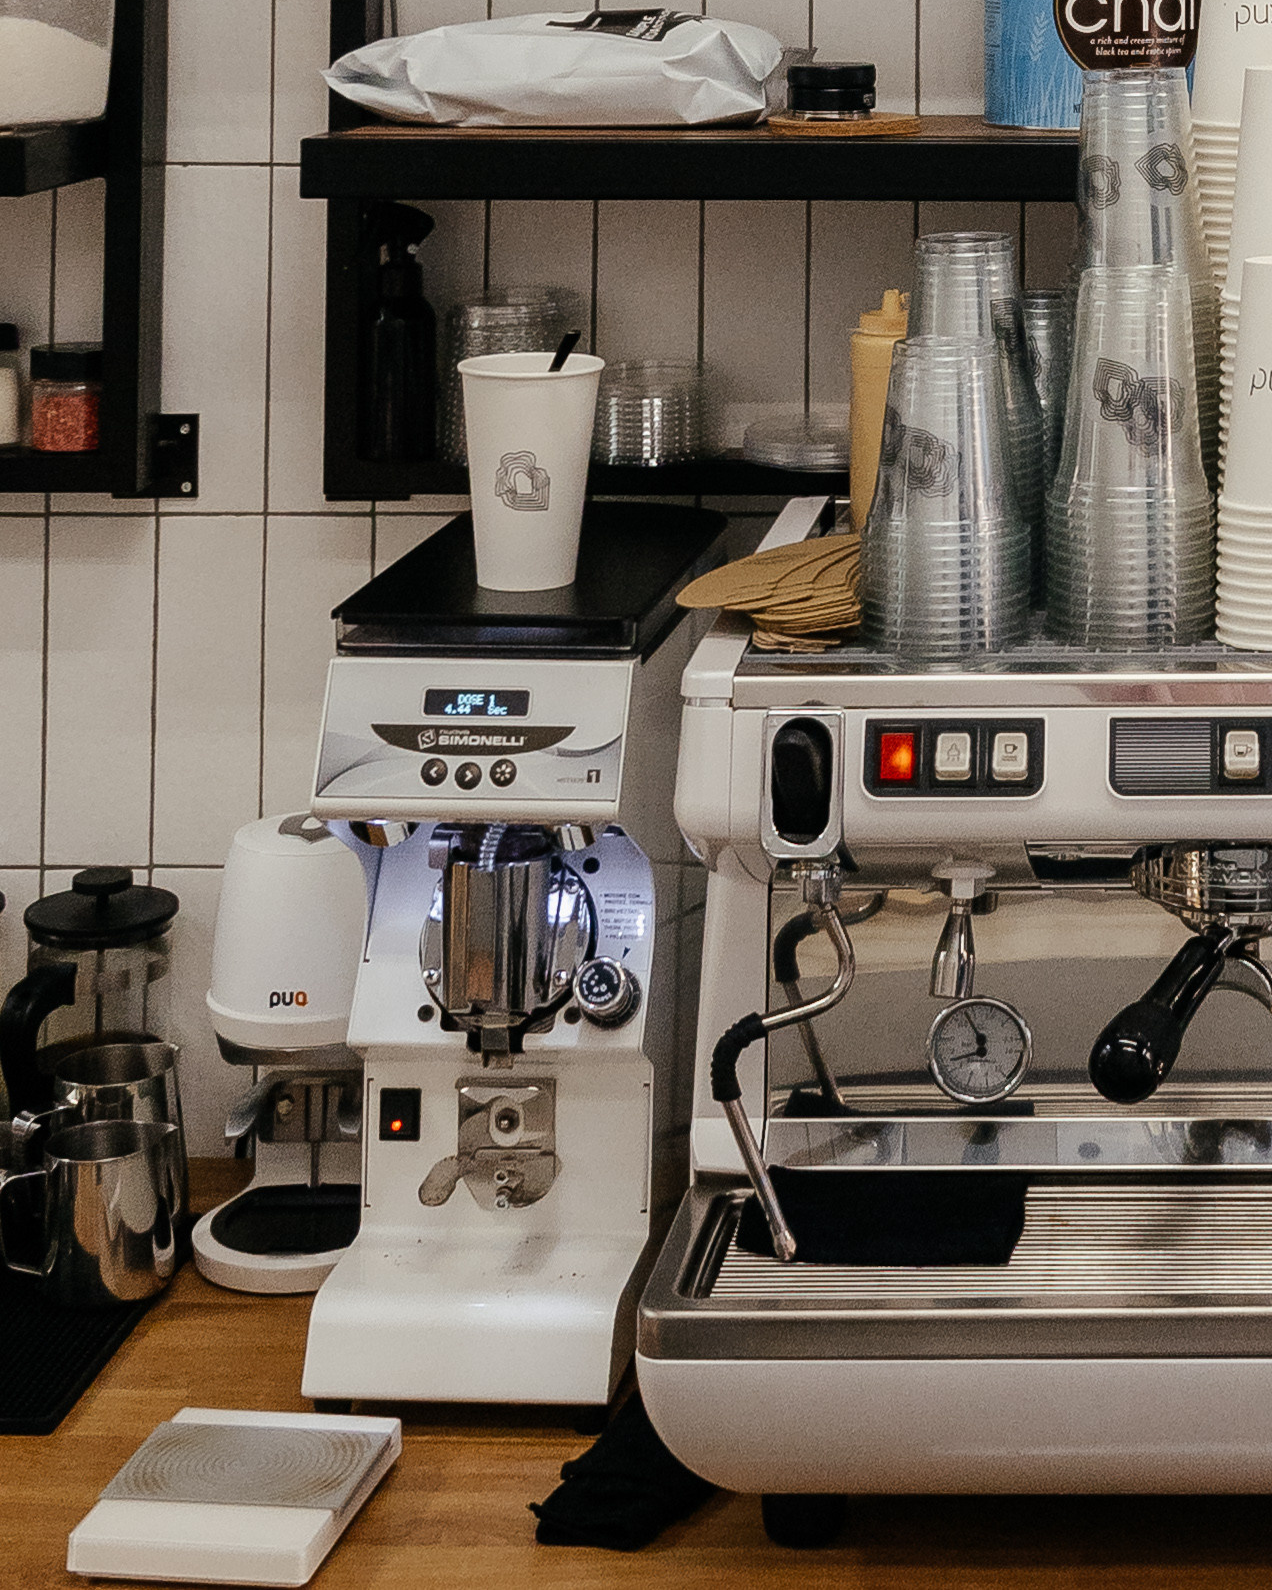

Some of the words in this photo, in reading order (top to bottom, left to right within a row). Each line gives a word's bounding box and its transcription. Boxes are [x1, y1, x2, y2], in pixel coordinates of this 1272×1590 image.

[1097, 36, 1113, 45] rich
[1113, 36, 1130, 45] and
[1130, 37, 1155, 47] creamy
[1095, 46, 1116, 56] black
[1130, 47, 1146, 56] and
[457, 693, 485, 706] DOSE
[489, 694, 496, 706] 1
[438, 735, 525, 747] SIMONELLI
